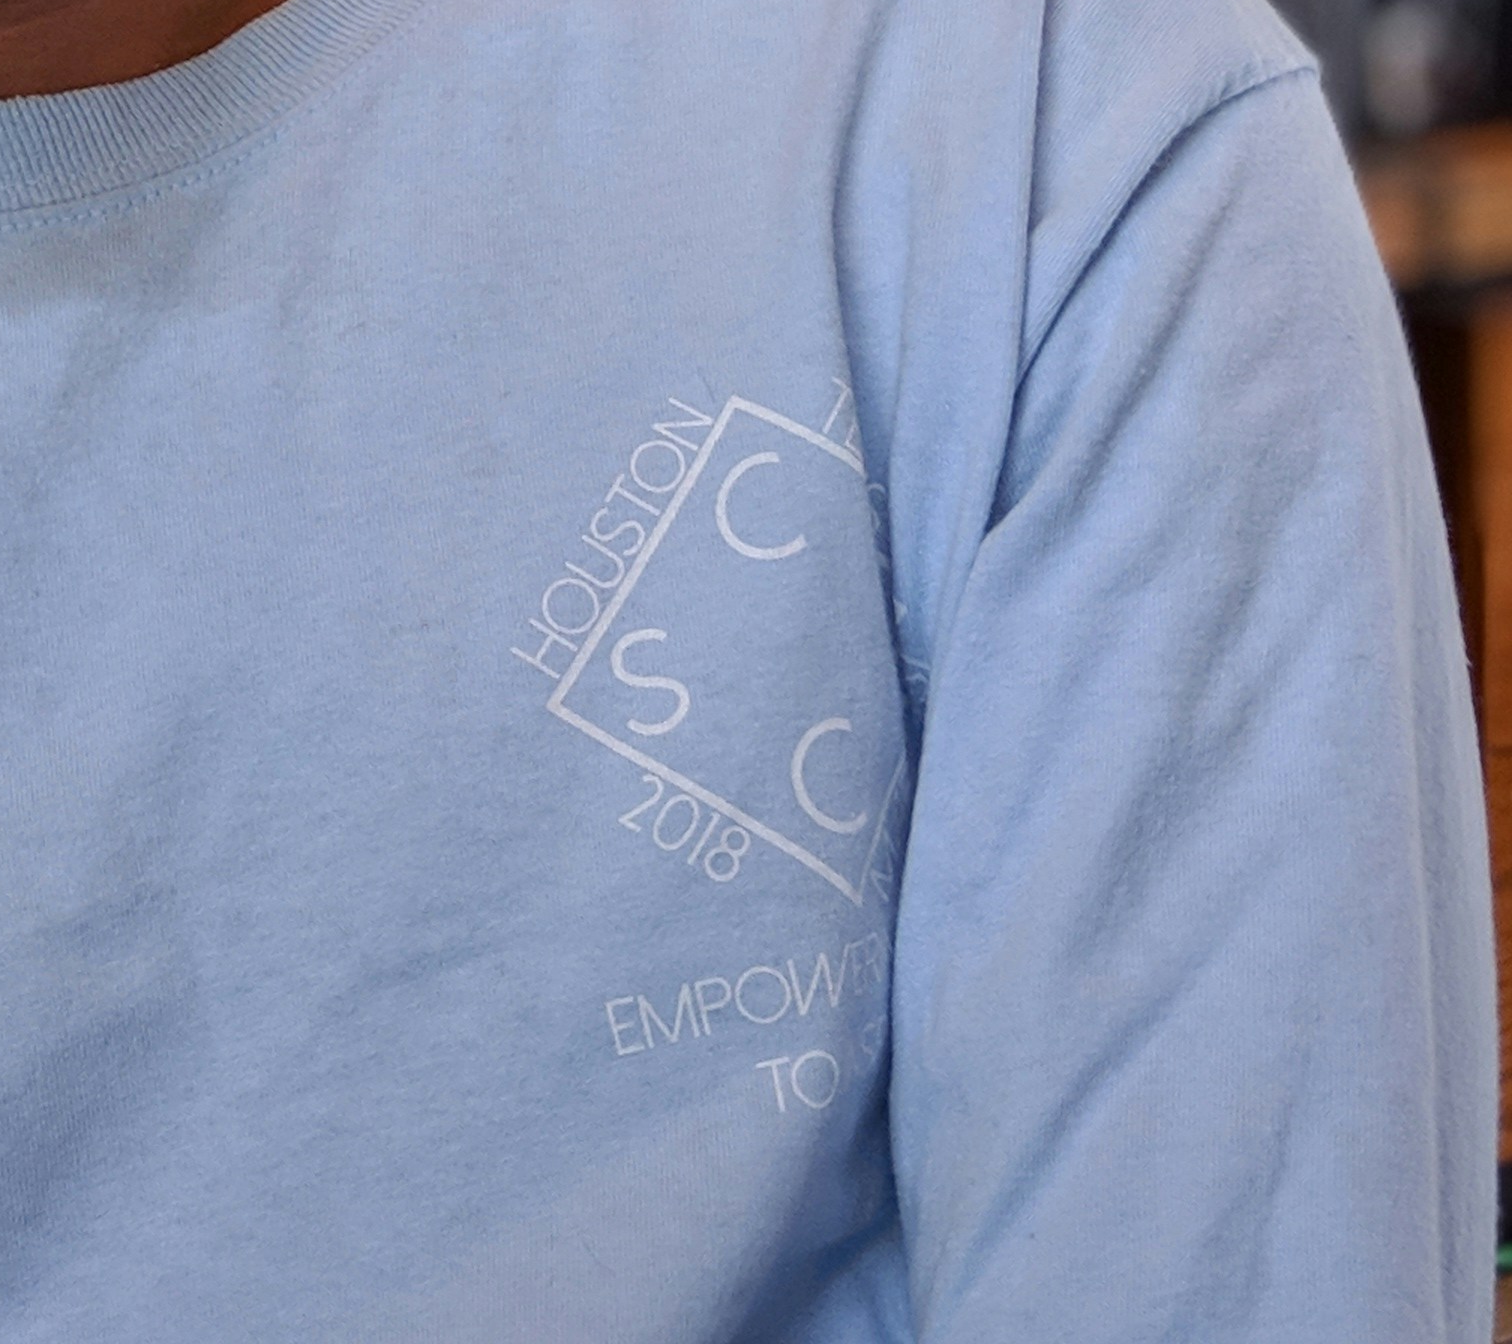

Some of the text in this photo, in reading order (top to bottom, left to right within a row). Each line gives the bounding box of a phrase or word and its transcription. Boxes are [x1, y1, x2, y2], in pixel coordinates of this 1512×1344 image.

[510, 397, 713, 679] HOUSTON
[716, 451, 808, 560] C
[610, 628, 690, 735] S
[618, 774, 751, 882] 2018
[791, 717, 868, 834] C
[755, 1049, 839, 1112] TO
